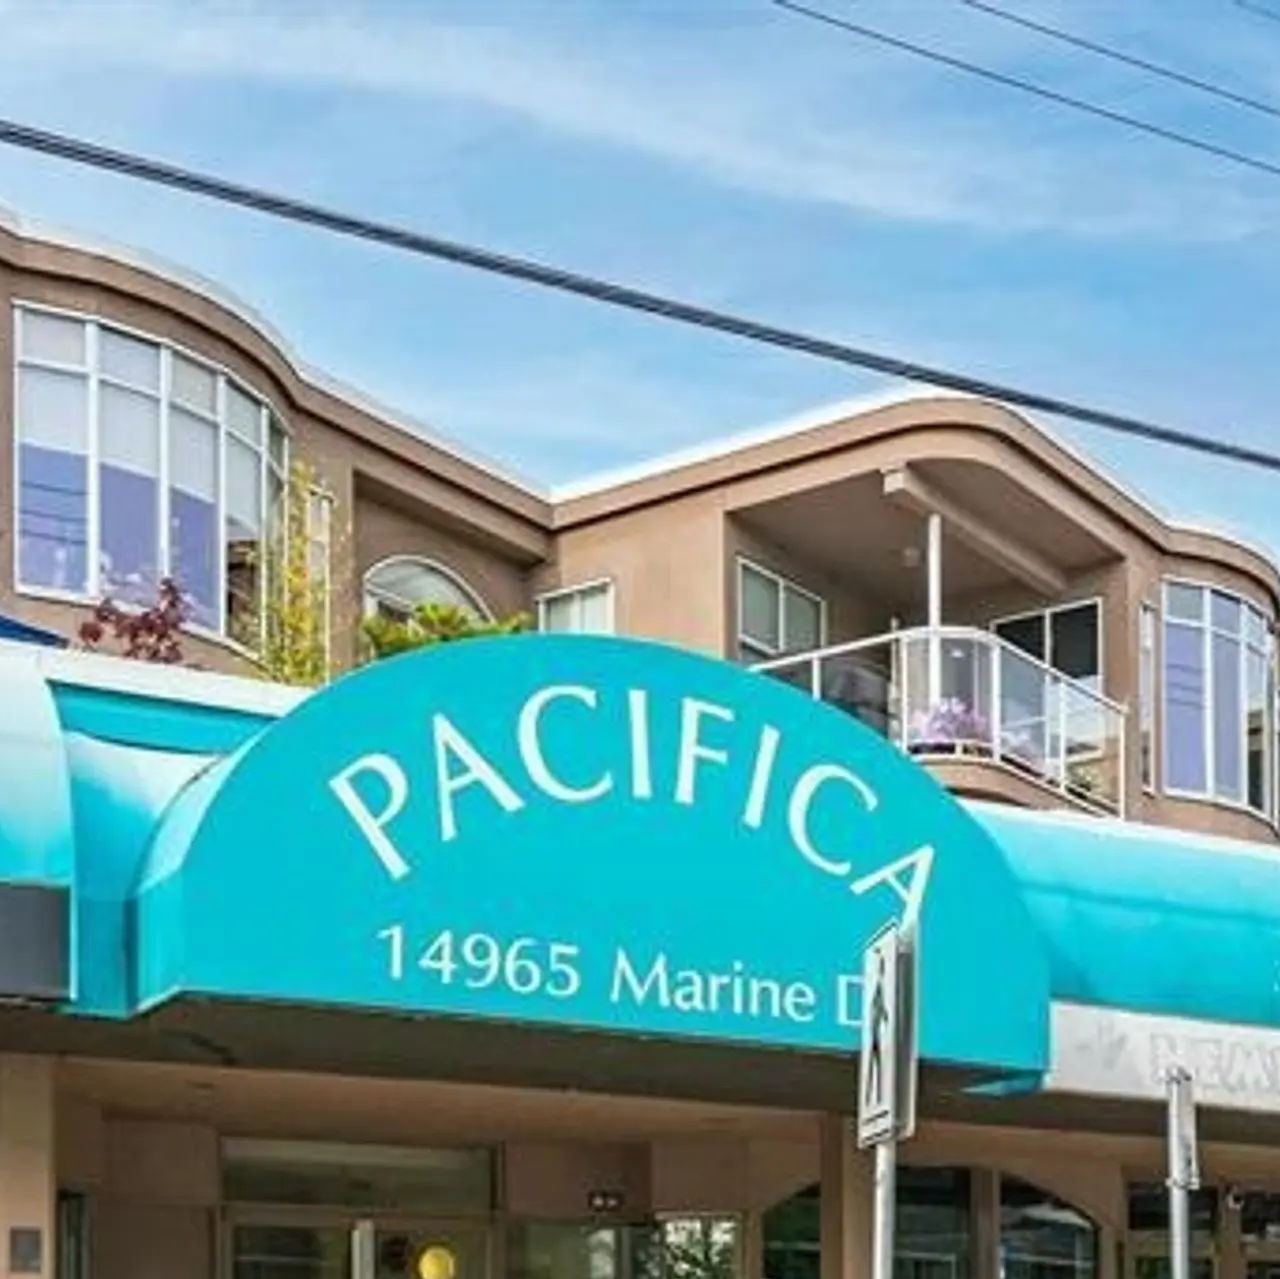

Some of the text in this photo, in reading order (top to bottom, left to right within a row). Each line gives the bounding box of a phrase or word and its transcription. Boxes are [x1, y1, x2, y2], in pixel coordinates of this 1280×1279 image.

[329, 685, 935, 937] PACIFICA
[378, 924, 581, 998] 14965
[609, 946, 816, 1023] Marine
